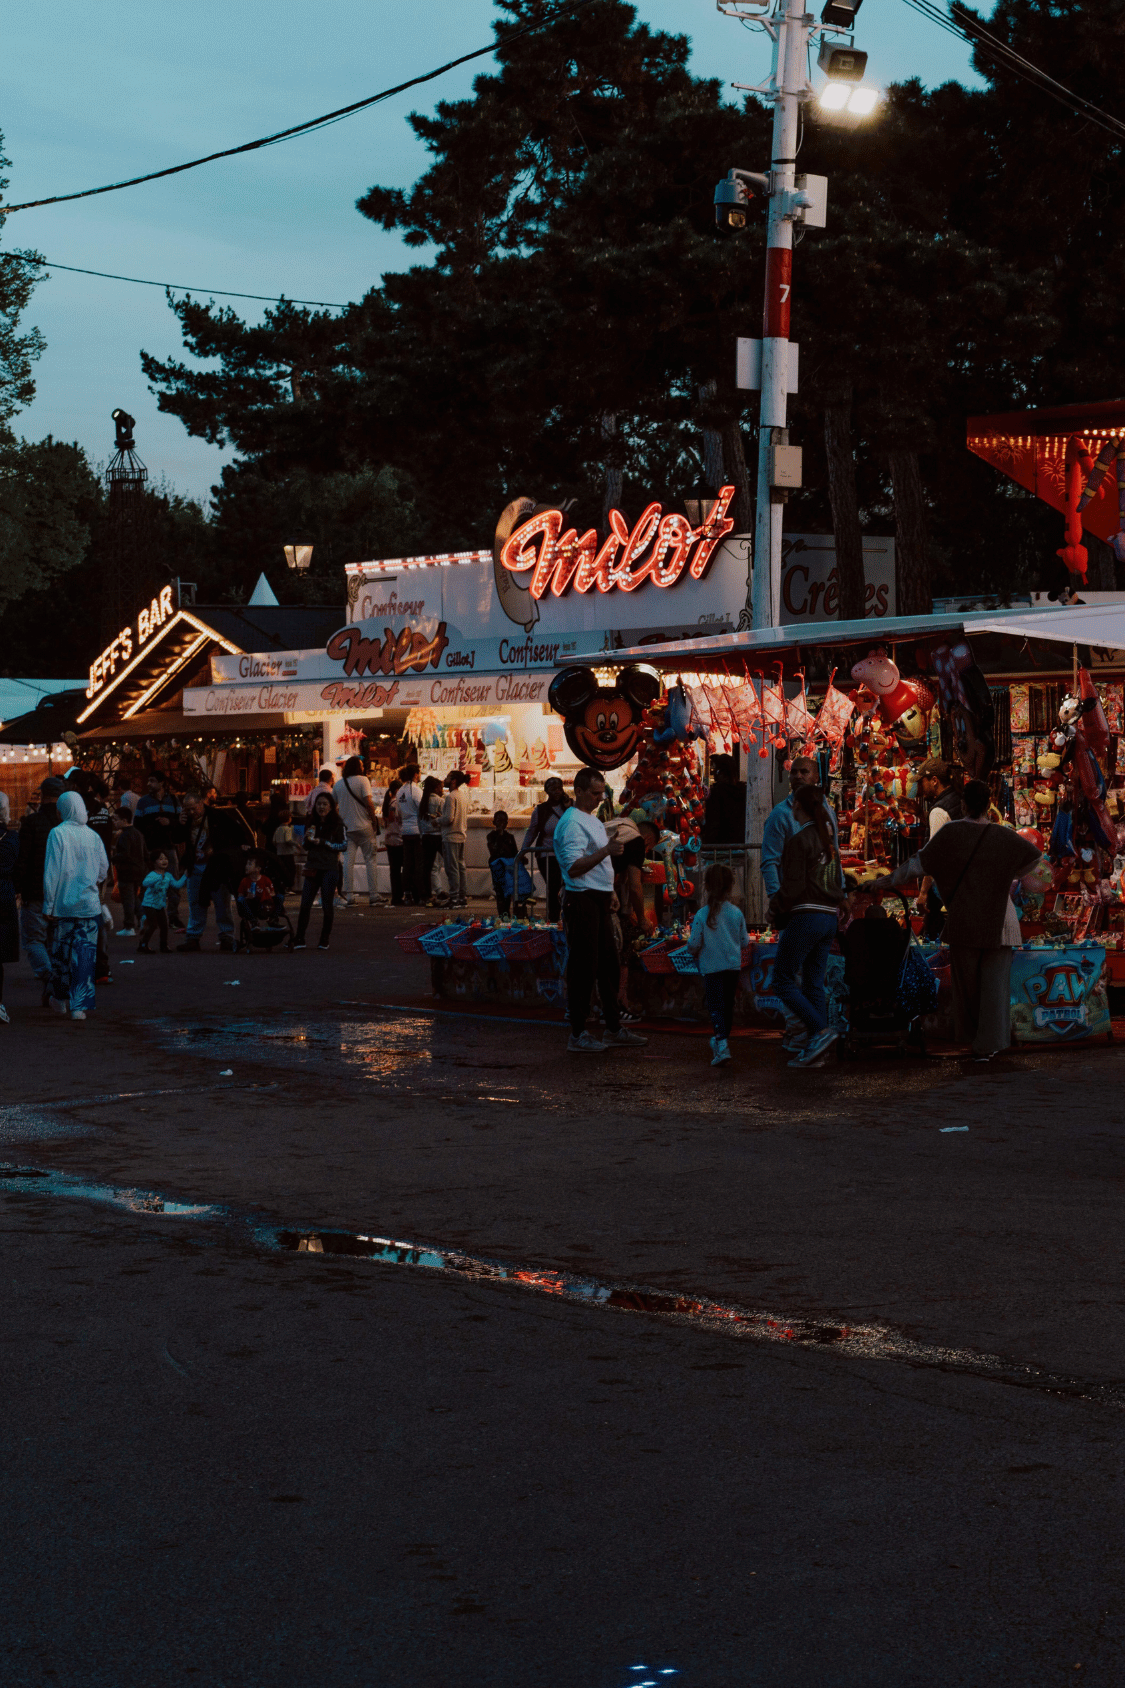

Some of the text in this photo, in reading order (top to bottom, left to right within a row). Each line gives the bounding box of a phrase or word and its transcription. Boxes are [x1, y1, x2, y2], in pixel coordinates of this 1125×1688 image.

[778, 284, 790, 304] 7
[361, 591, 425, 619] Confiseur
[783, 565, 889, 616] Crêes
[137, 584, 174, 645] BAR
[239, 655, 283, 678] Glacier
[499, 635, 560, 667] Confiseur
[205, 685, 299, 714] Confiseur Glacier
[430, 673, 546, 707] Confiseur Glacier
[1022, 972, 1096, 1006] PAW
